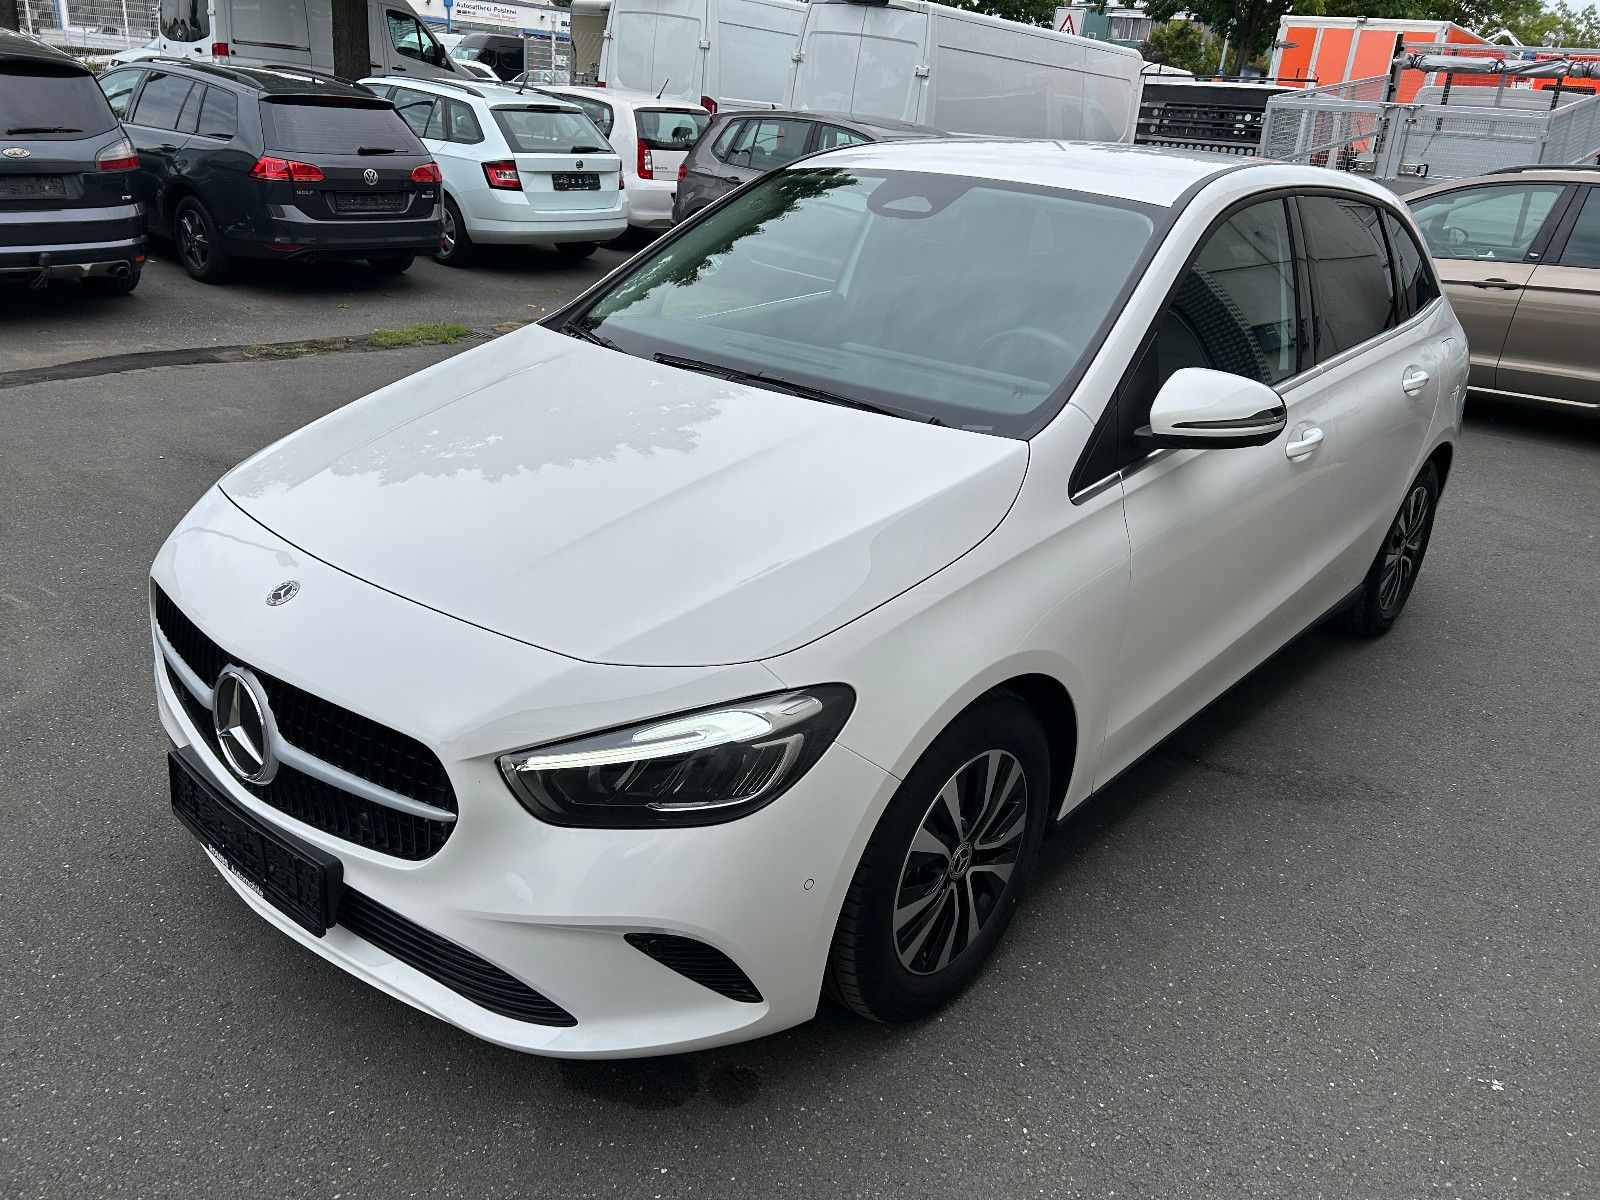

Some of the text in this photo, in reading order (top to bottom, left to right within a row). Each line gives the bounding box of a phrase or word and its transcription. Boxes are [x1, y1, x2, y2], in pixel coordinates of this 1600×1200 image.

[456, 2, 517, 15] Autosattlerei Polsterei
[230, 864, 264, 898] Automobile
